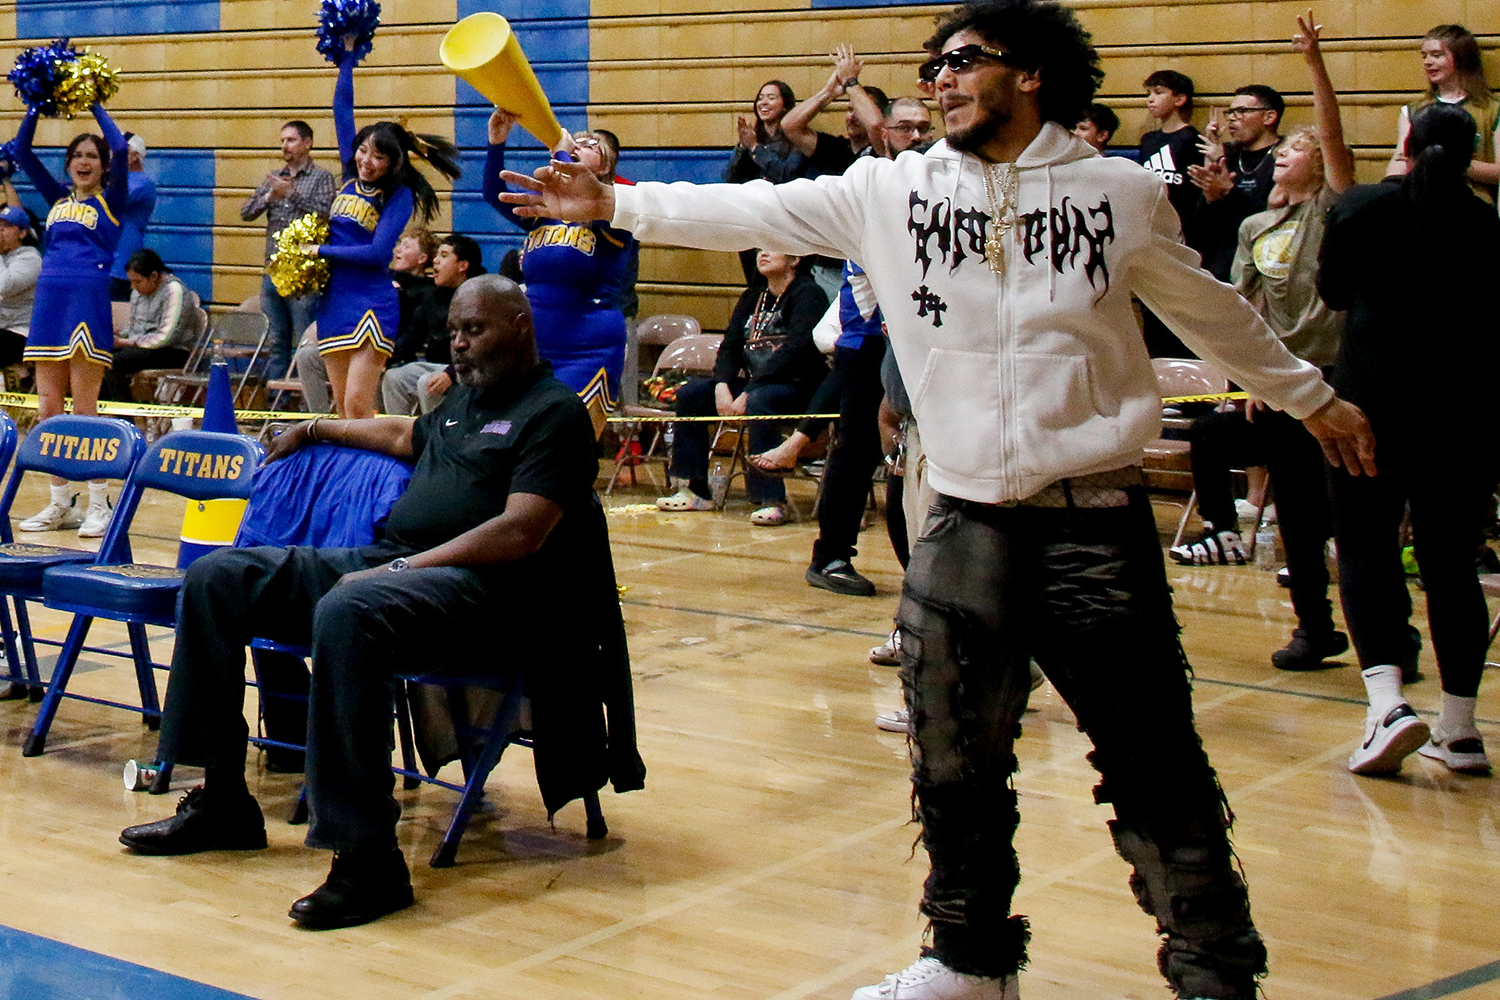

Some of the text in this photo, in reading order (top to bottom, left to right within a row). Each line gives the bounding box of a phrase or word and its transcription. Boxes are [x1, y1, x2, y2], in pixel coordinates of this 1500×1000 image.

[527, 224, 596, 256] TITANS
[39, 432, 120, 461] TITANS
[159, 448, 244, 480] TITANS
